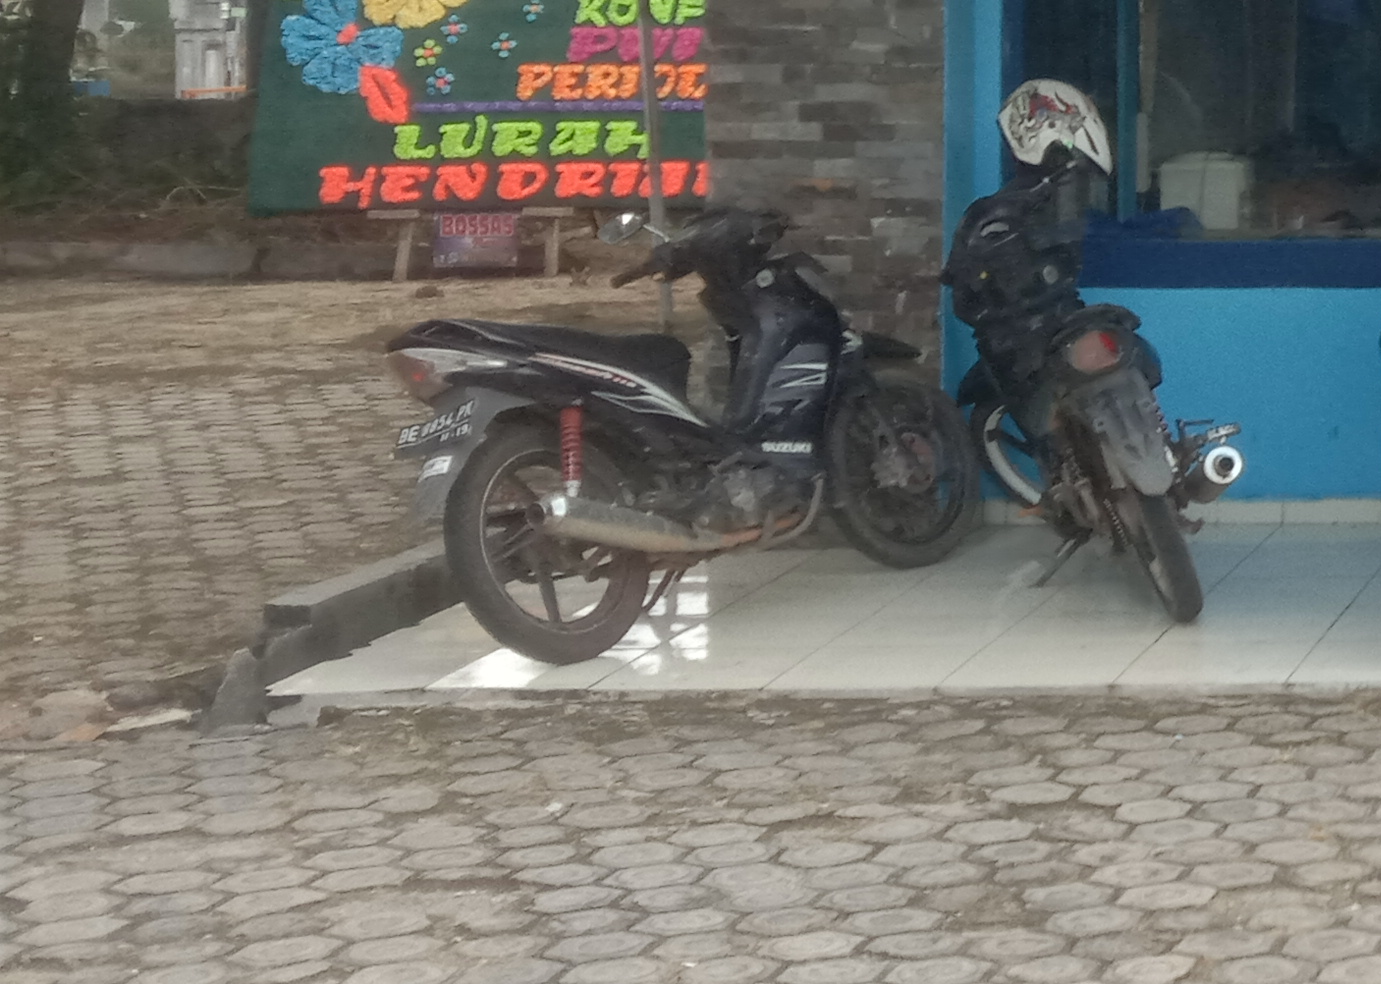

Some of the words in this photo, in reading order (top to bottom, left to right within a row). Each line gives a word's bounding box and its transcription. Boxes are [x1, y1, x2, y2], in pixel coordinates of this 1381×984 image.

[393, 114, 650, 160] LURAH
[398, 424, 420, 445] BE
[761, 441, 813, 454] SUZUKI
